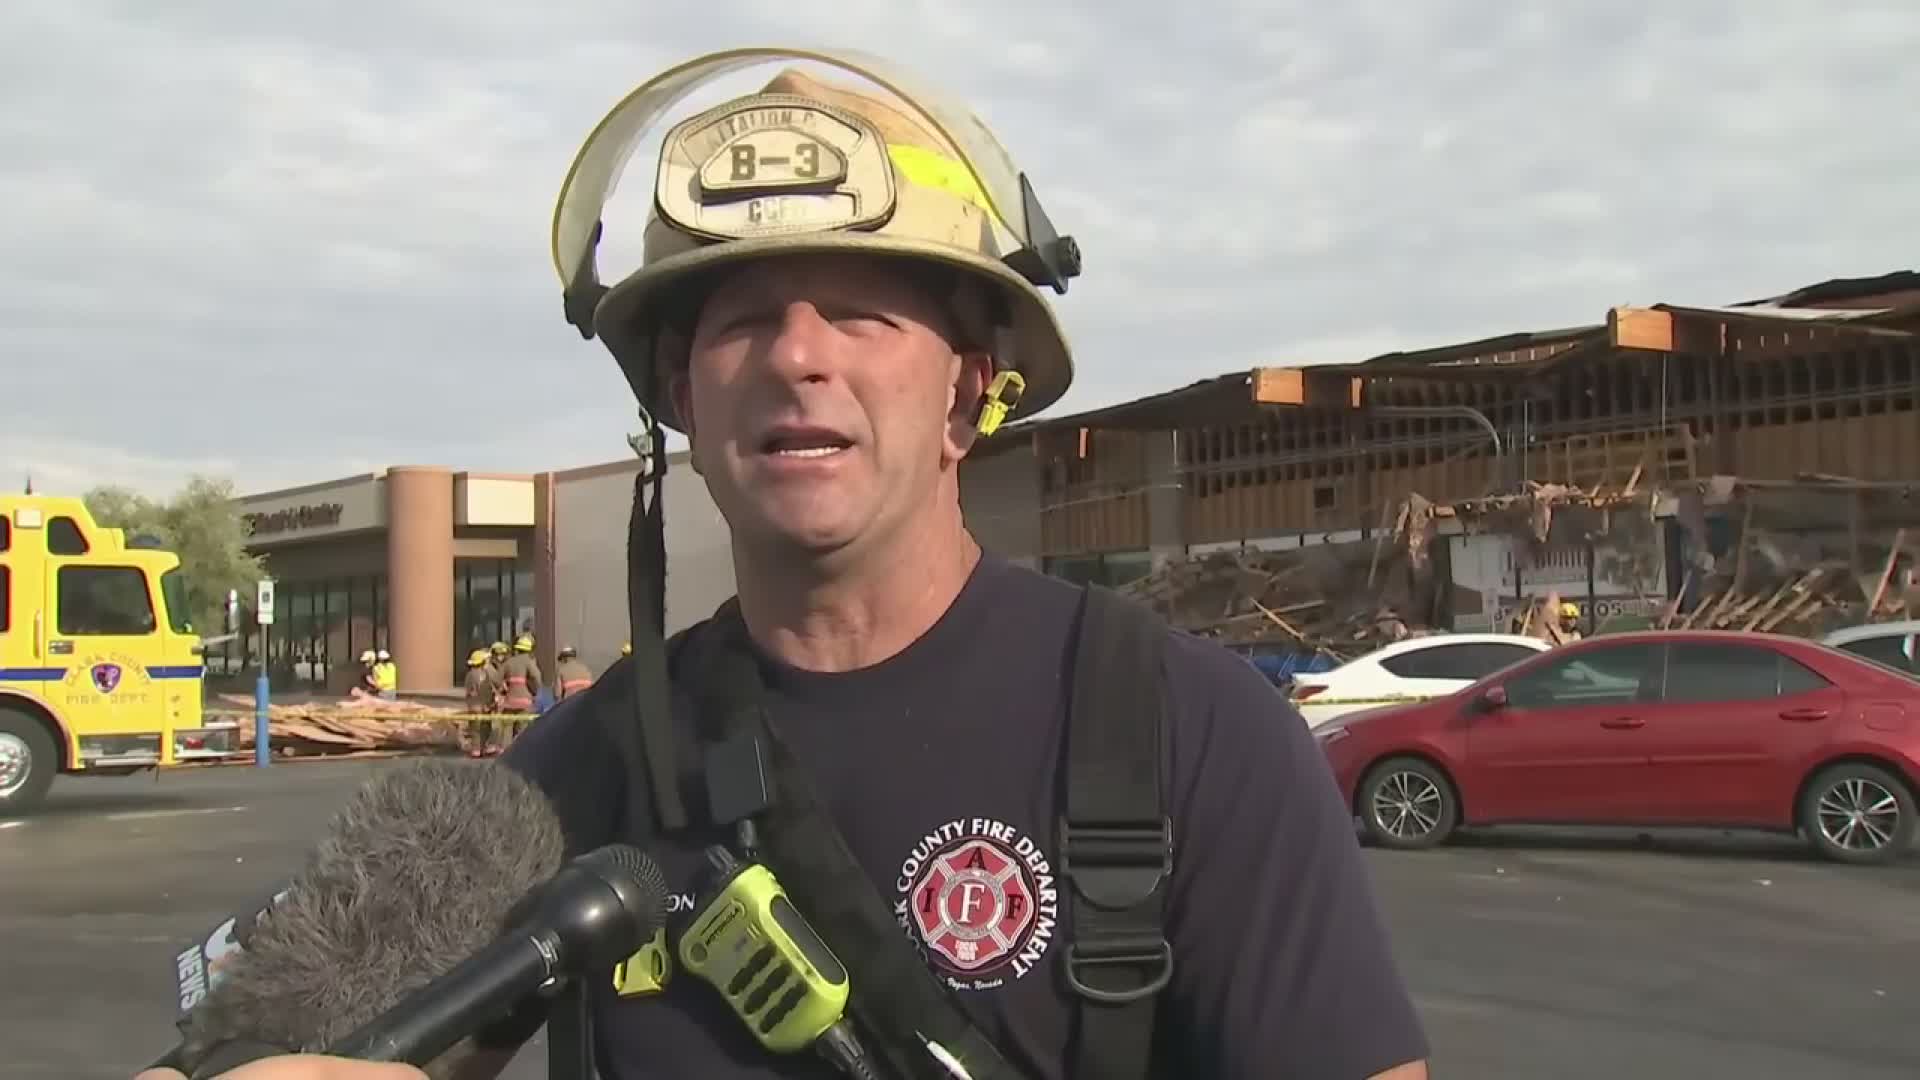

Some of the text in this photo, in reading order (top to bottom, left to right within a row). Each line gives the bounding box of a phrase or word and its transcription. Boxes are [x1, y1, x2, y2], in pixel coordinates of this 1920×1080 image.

[730, 143, 820, 181] B-3
[896, 818, 966, 893] COUNTY
[972, 818, 1017, 844] FIRE
[1011, 836, 1057, 979] DEPARTMENT
[176, 944, 207, 1012] NEWS
